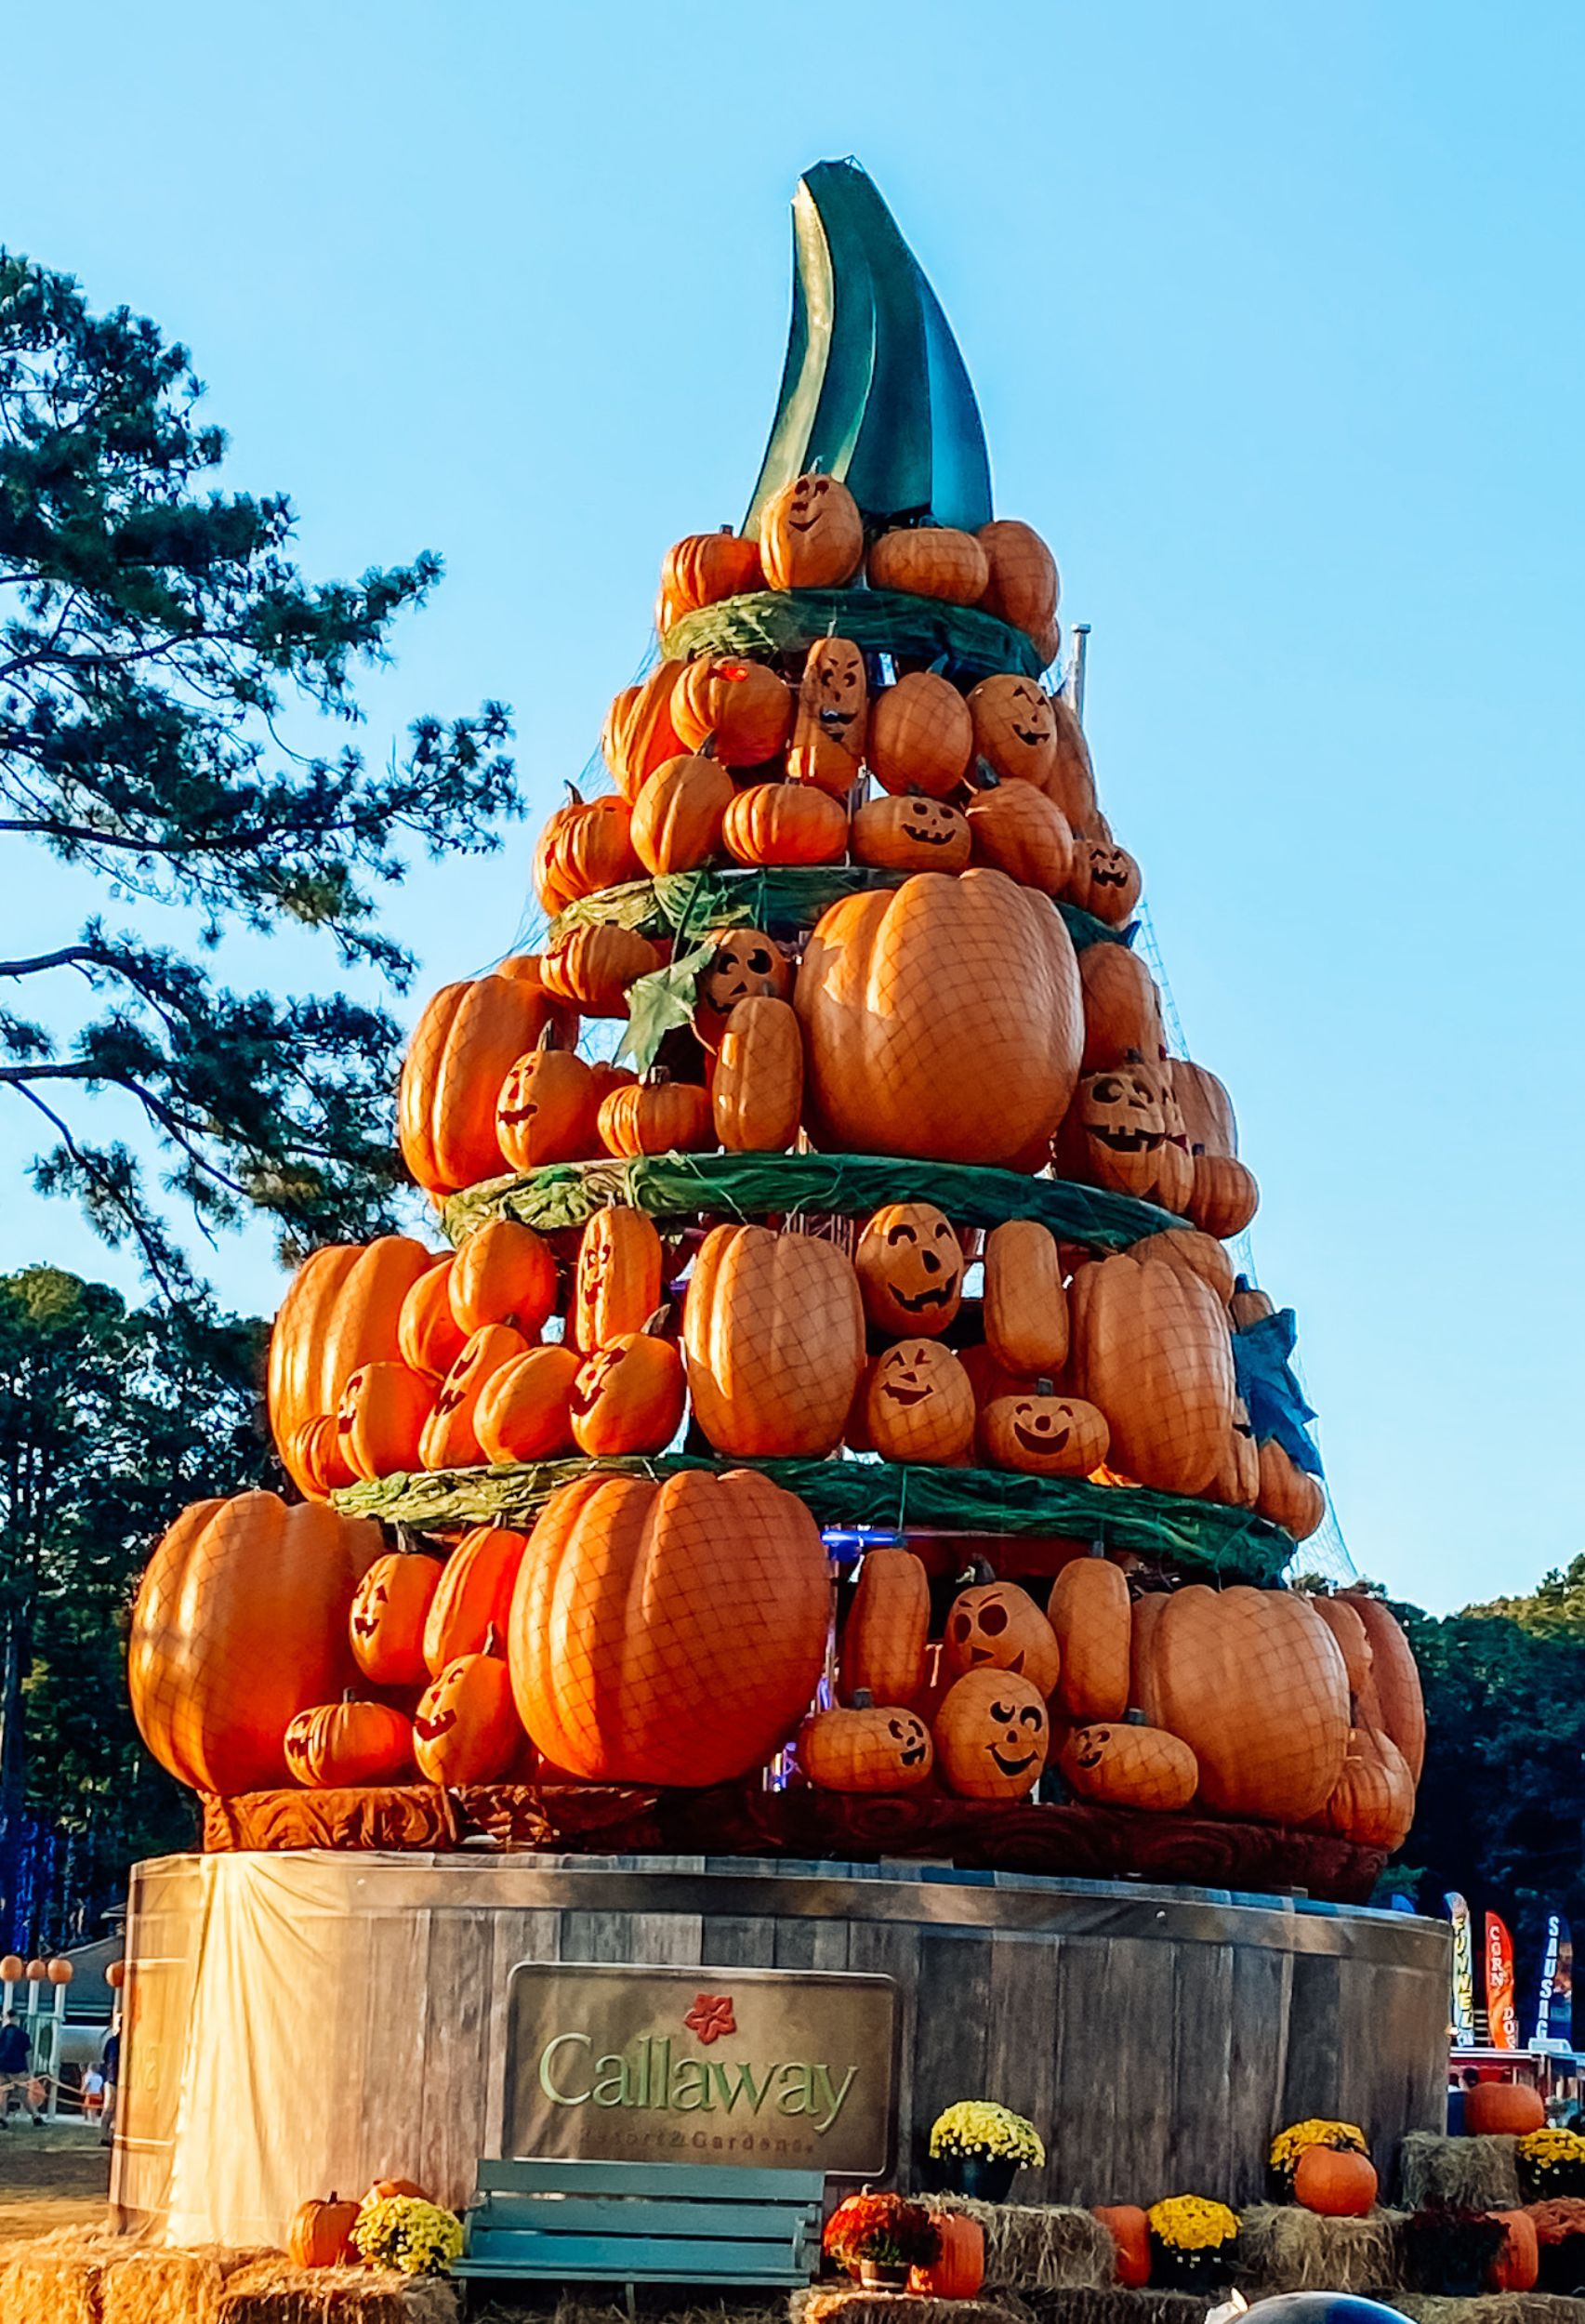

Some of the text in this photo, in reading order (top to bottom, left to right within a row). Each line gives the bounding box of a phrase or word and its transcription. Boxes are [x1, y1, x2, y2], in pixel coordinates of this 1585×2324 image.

[1453, 1916, 1472, 2027] FUNNEL
[1489, 1925, 1504, 1987] CORN
[538, 2031, 858, 2135] Callaway
